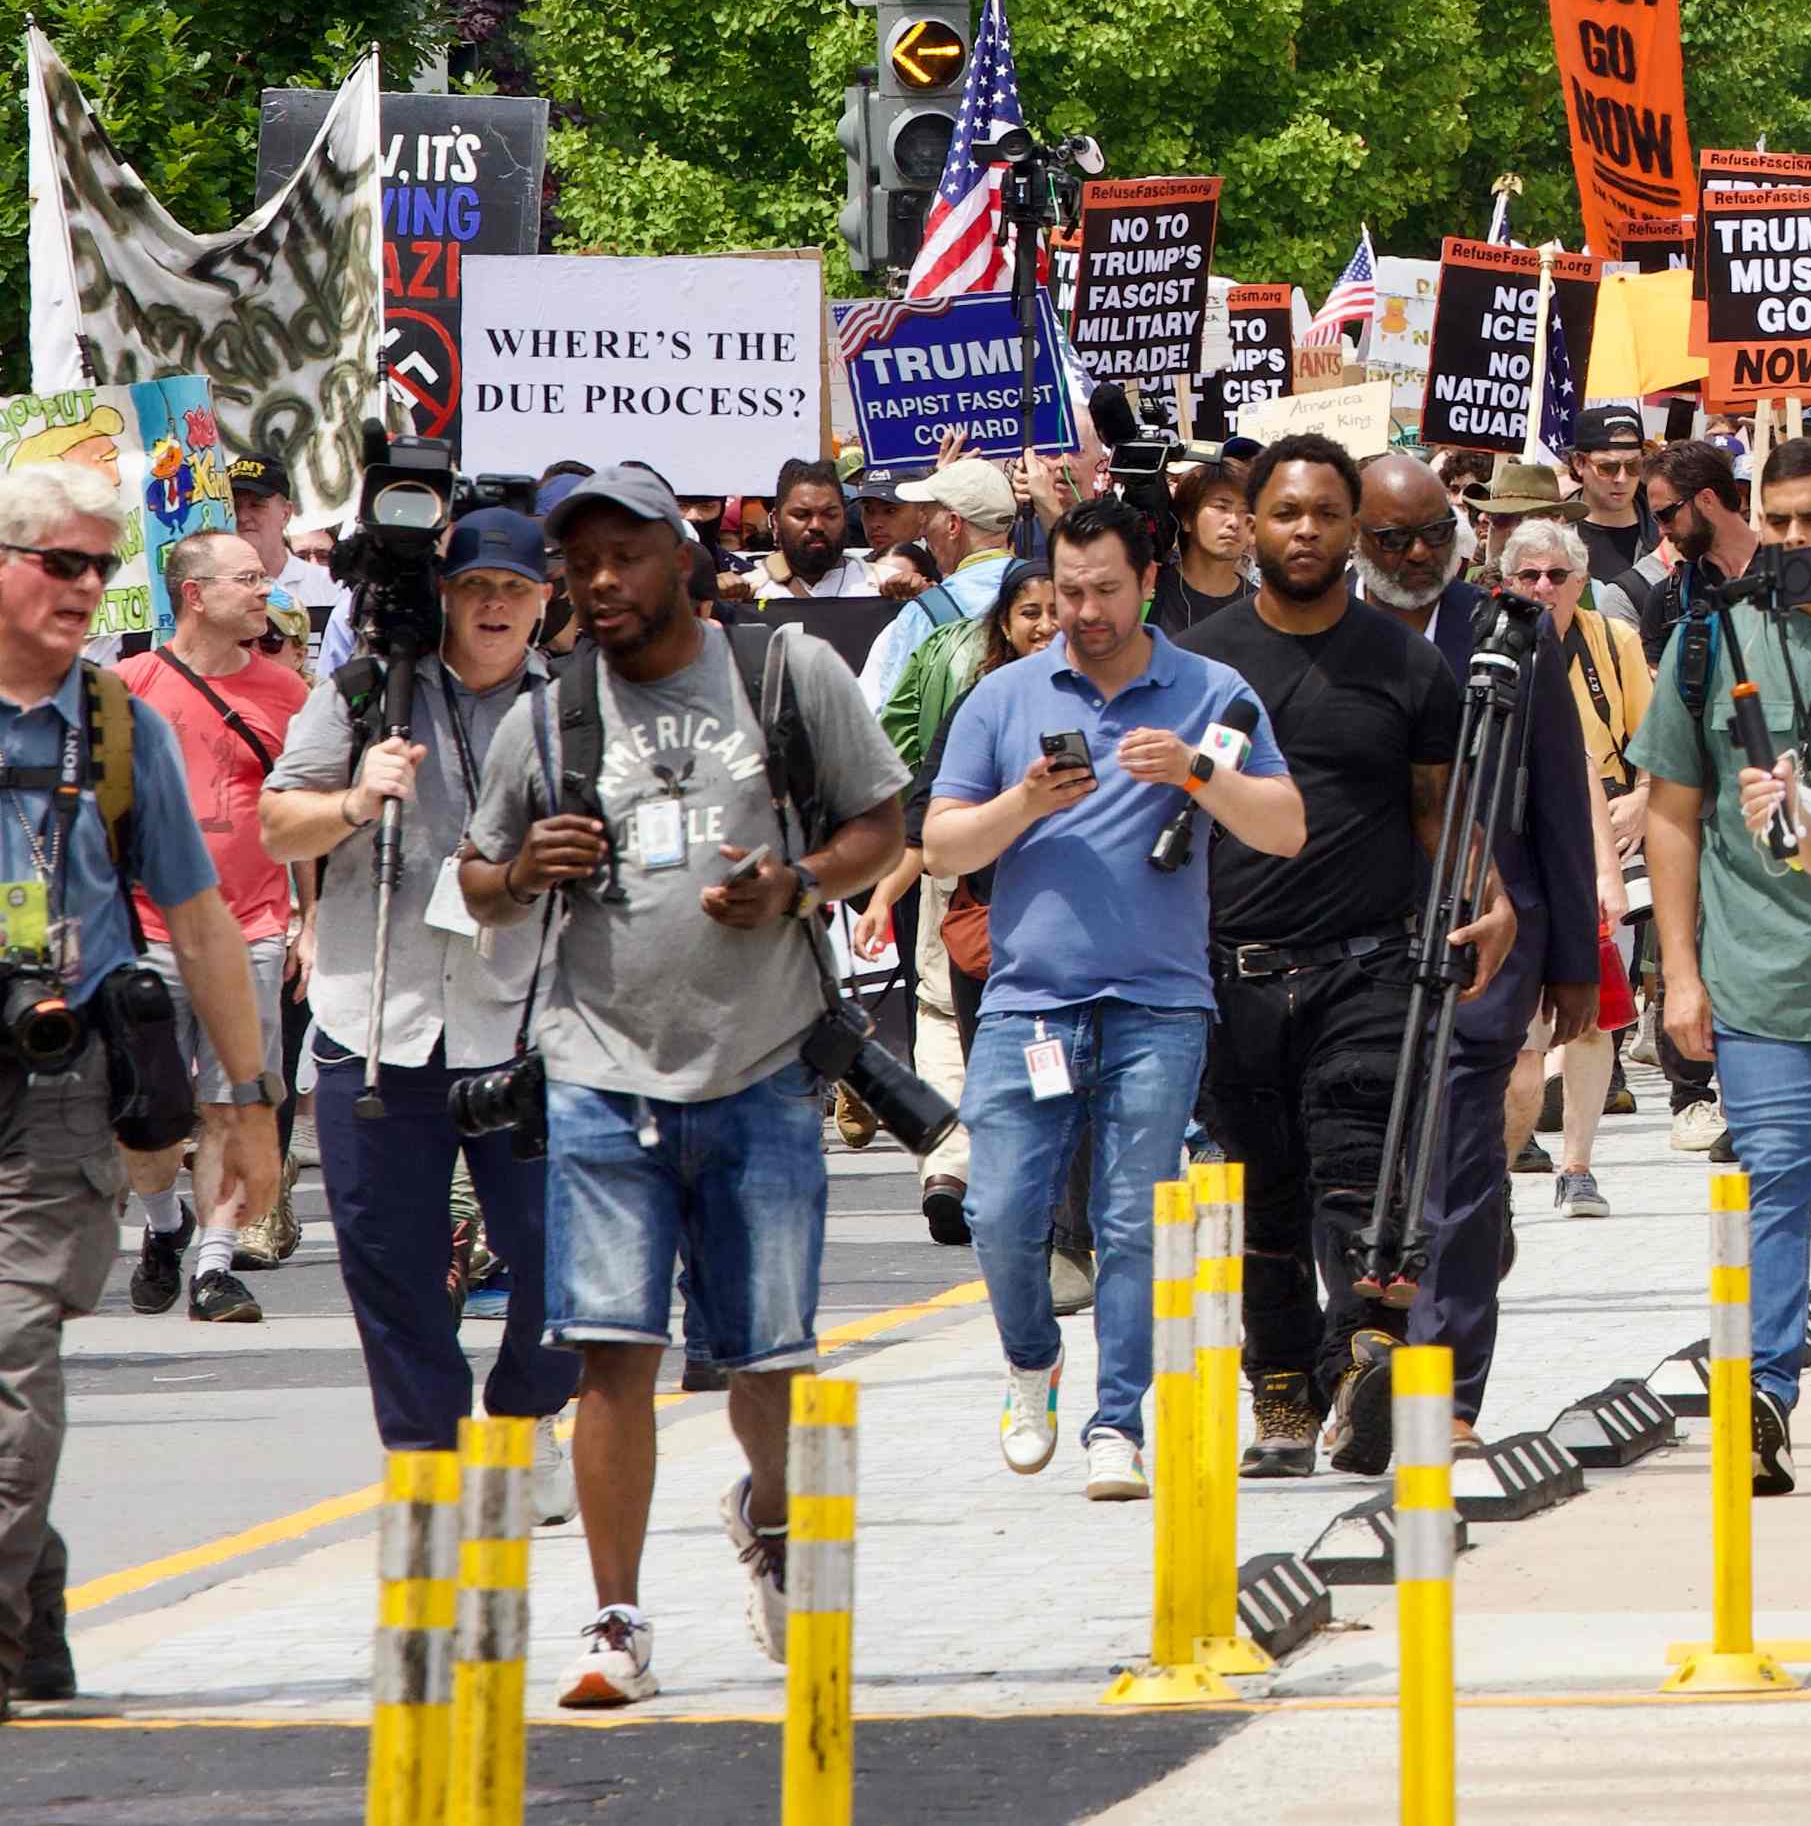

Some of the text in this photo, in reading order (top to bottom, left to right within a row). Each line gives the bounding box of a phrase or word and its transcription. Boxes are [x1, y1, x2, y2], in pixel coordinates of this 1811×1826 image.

[1578, 19, 1637, 84] GO
[1572, 75, 1673, 179] NOW
[417, 125, 482, 183] IT'S
[1091, 182, 1212, 202] RefuseFascism.org
[1110, 212, 1189, 244] NO TO
[1090, 245, 1202, 276] TRUMP'S
[1088, 278, 1196, 311] FASCIST
[1493, 285, 1542, 314] NO
[1077, 310, 1199, 343] MILITARY
[1231, 318, 1267, 343] TO
[708, 331, 797, 362] THE
[862, 337, 1041, 385] TRUMP
[1082, 343, 1190, 376] PARADE!
[1487, 351, 1531, 380] NO
[43, 390, 97, 426] PUT
[477, 383, 806, 418] DUE PROCESS?
[867, 393, 951, 420] RAPIST
[1290, 392, 1363, 418] America
[914, 417, 1020, 446] COWARD
[1337, 414, 1376, 430] King
[62, 726, 80, 783] SONY
[597, 714, 765, 798] AMERICAN
